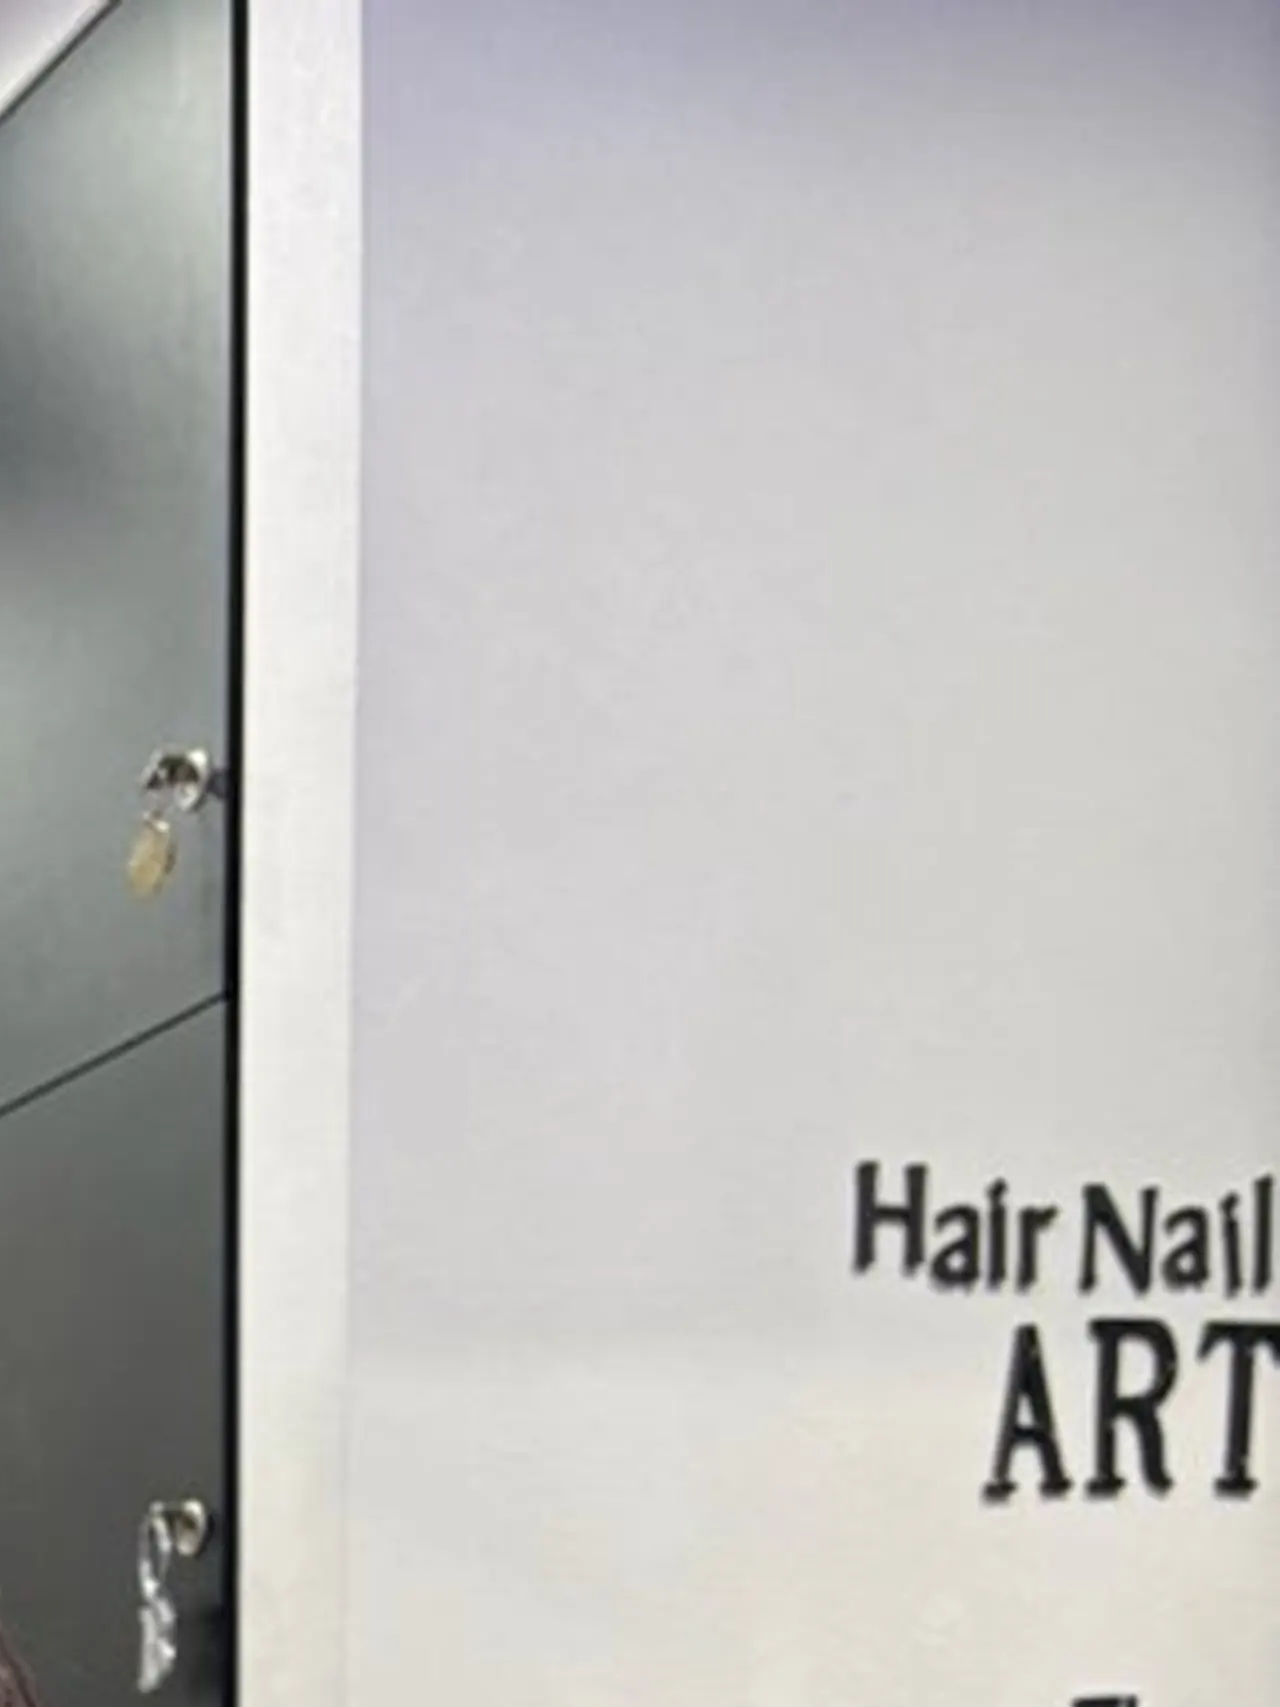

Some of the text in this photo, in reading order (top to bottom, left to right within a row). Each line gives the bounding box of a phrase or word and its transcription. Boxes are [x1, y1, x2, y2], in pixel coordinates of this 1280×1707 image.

[852, 1159, 1275, 1298] Hair Nail
[980, 1317, 1280, 1502] ART
